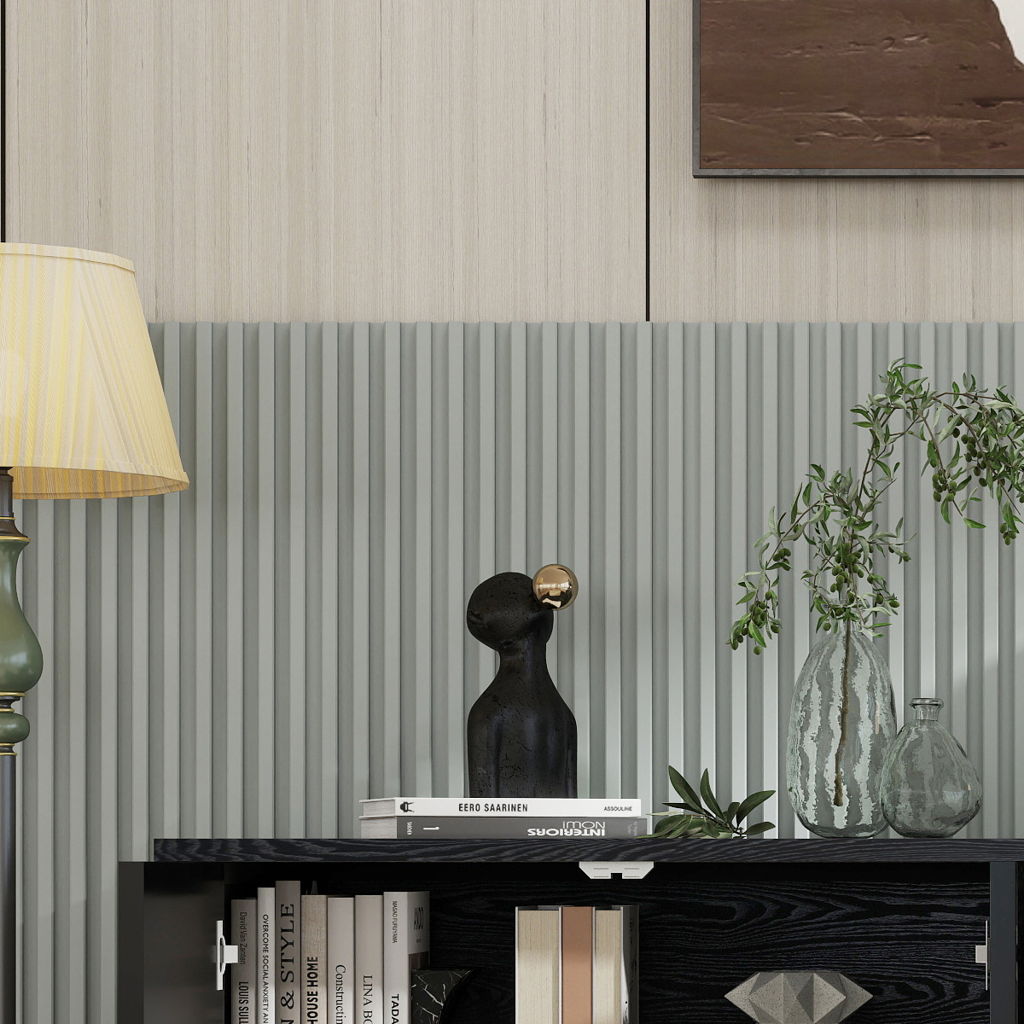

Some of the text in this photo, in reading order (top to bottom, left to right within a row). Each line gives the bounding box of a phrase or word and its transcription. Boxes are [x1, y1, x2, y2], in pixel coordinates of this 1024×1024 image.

[458, 803, 529, 812] EERO SAARINEN
[527, 827, 606, 837] INTERIORS
[239, 911, 249, 930] David
[262, 914, 270, 953] OVERCOME
[280, 904, 295, 983] STYLE
[262, 955, 270, 979] SOCIAL
[306, 957, 318, 988] HOME
[238, 981, 249, 1005] LOUIS
[262, 980, 270, 1012] ANXIETY
[280, 991, 295, 1010] &
[363, 975, 373, 1006] LINA
